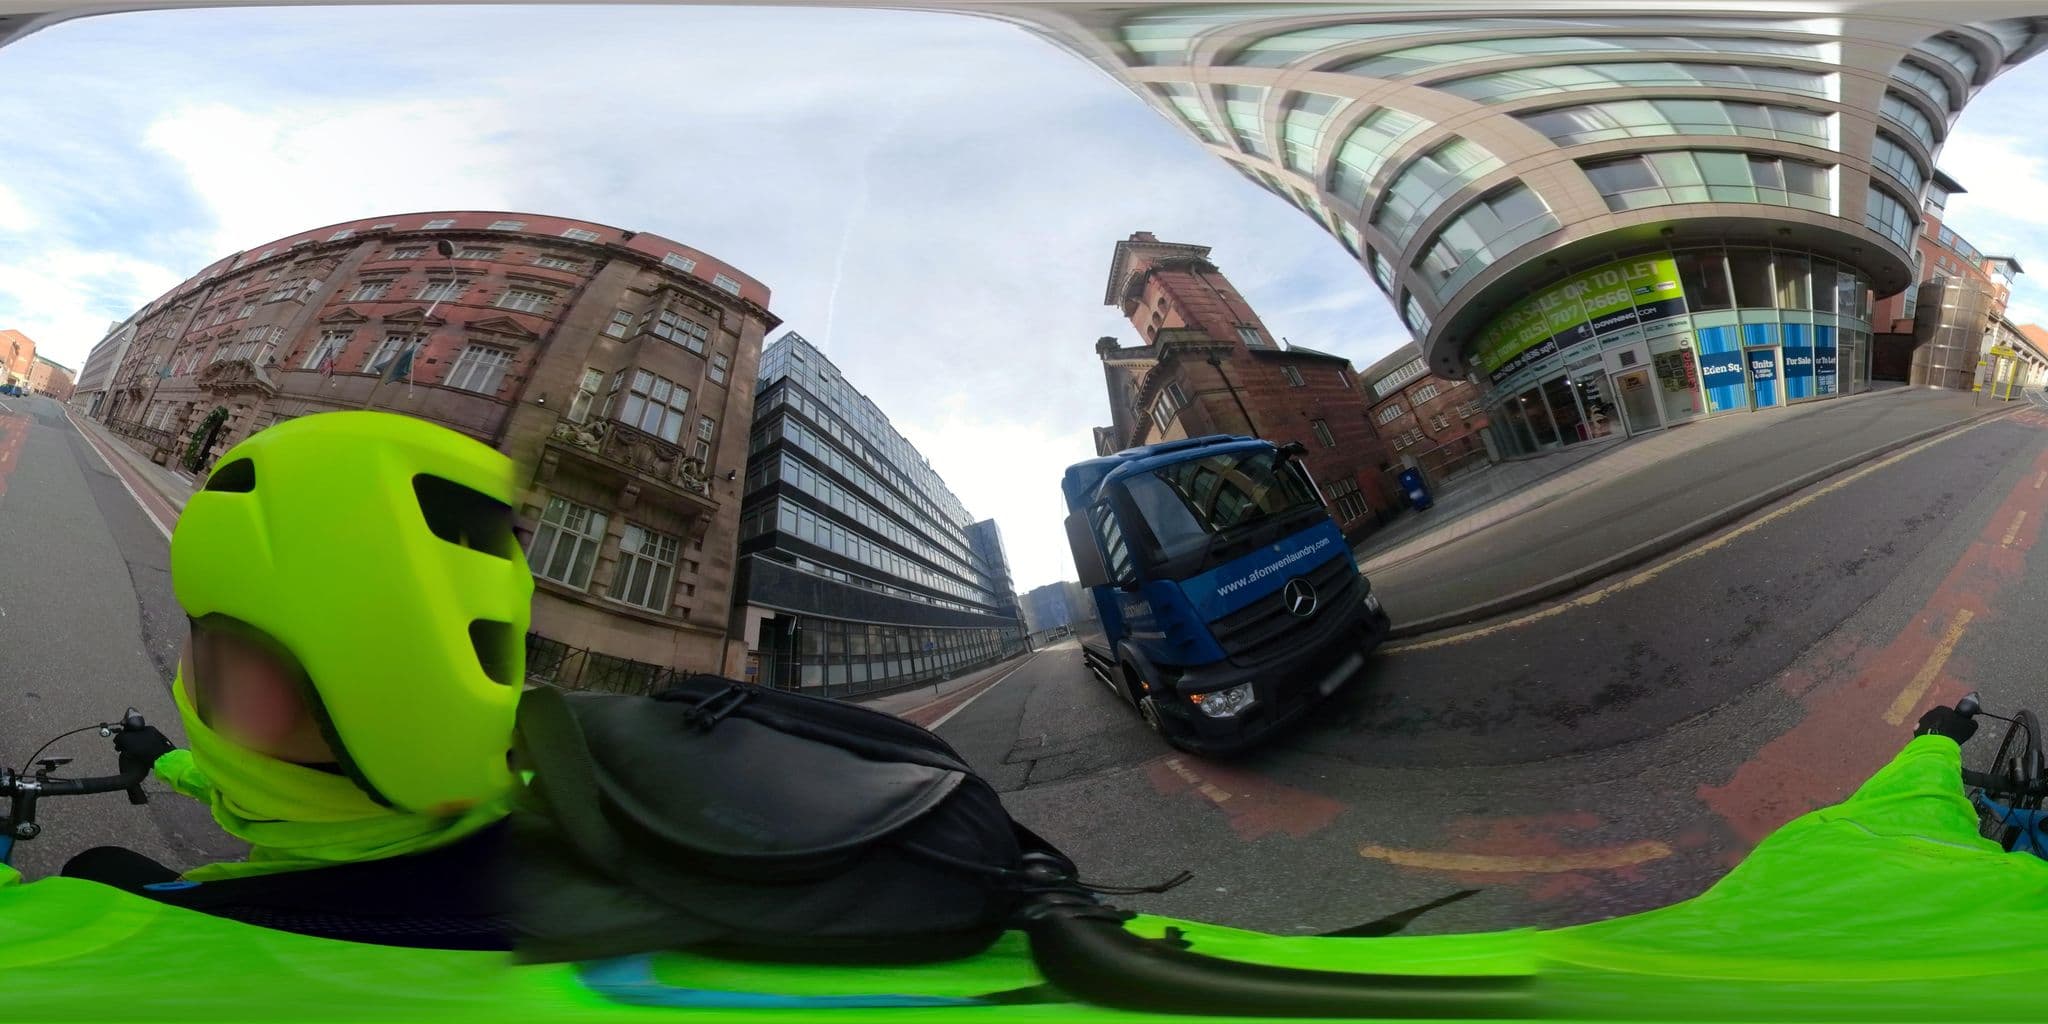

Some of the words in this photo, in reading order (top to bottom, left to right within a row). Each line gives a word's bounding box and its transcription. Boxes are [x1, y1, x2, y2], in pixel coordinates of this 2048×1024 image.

[1565, 281, 1592, 299] OR
[1592, 270, 1618, 289] TO
[1624, 261, 1658, 281] LET
[1550, 305, 1578, 326] 707
[1584, 288, 1629, 311] 2666
[1703, 364, 1728, 376] Eden
[1728, 363, 1743, 373] Sq.
[1752, 359, 1774, 369] Units
[1786, 358, 1798, 366] For
[1798, 357, 1812, 365] Sale
[1217, 537, 1330, 597] www.afonwenlaundry.com
